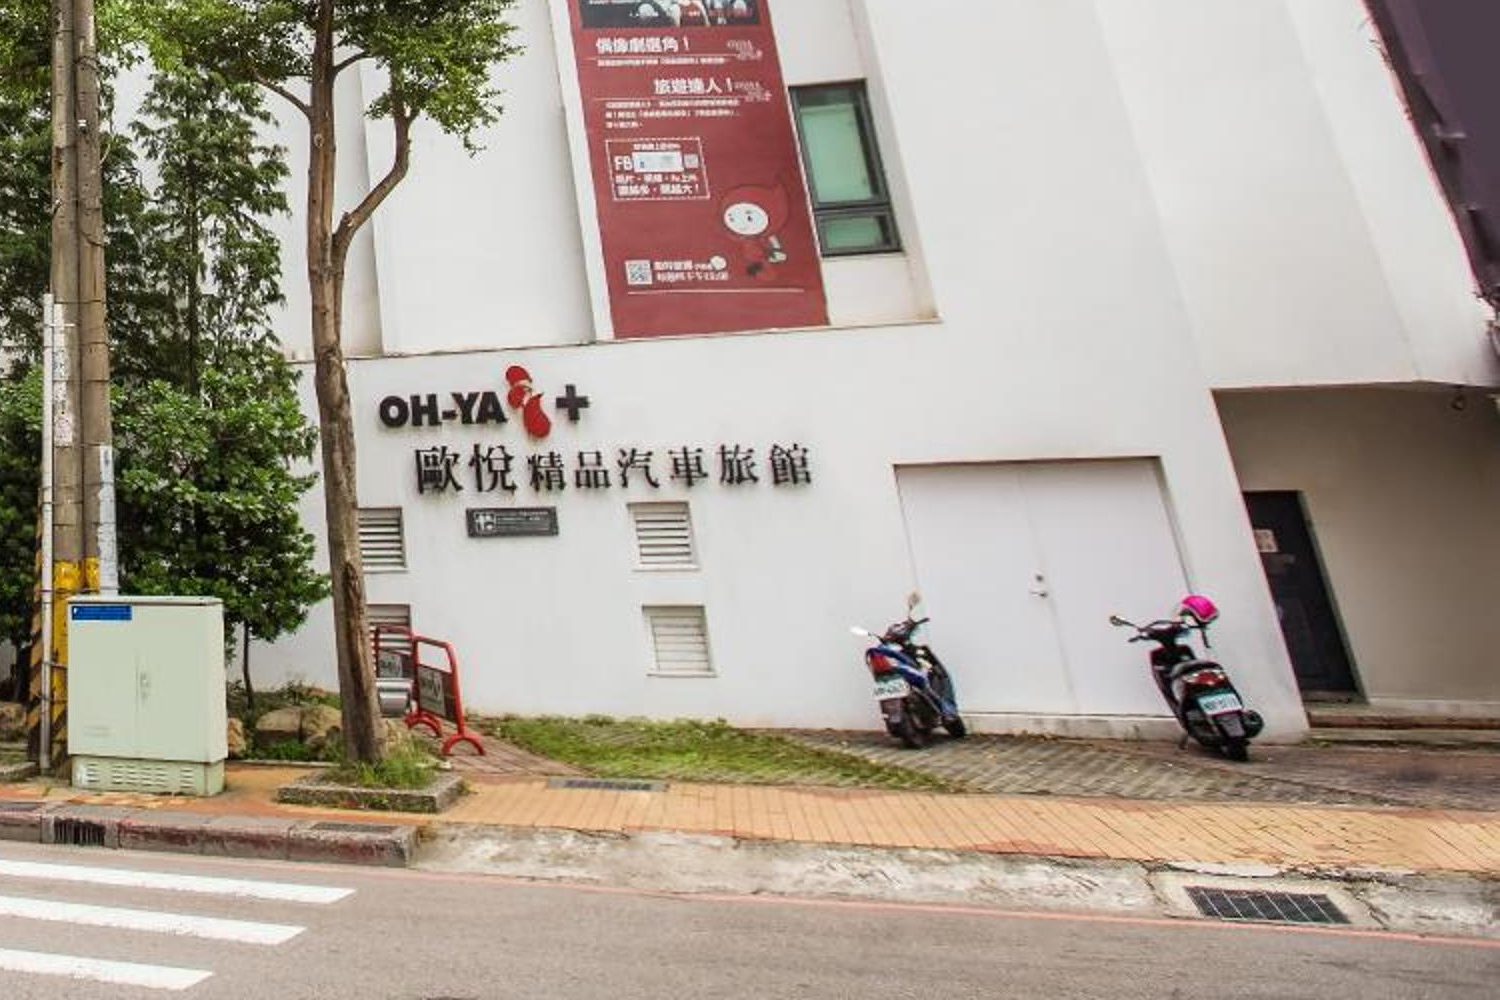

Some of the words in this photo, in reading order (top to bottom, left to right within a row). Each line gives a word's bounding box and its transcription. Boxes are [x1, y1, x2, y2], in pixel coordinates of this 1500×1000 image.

[379, 391, 508, 428] OH-YA
[414, 442, 813, 496] 歐悅精品汽車旅館
